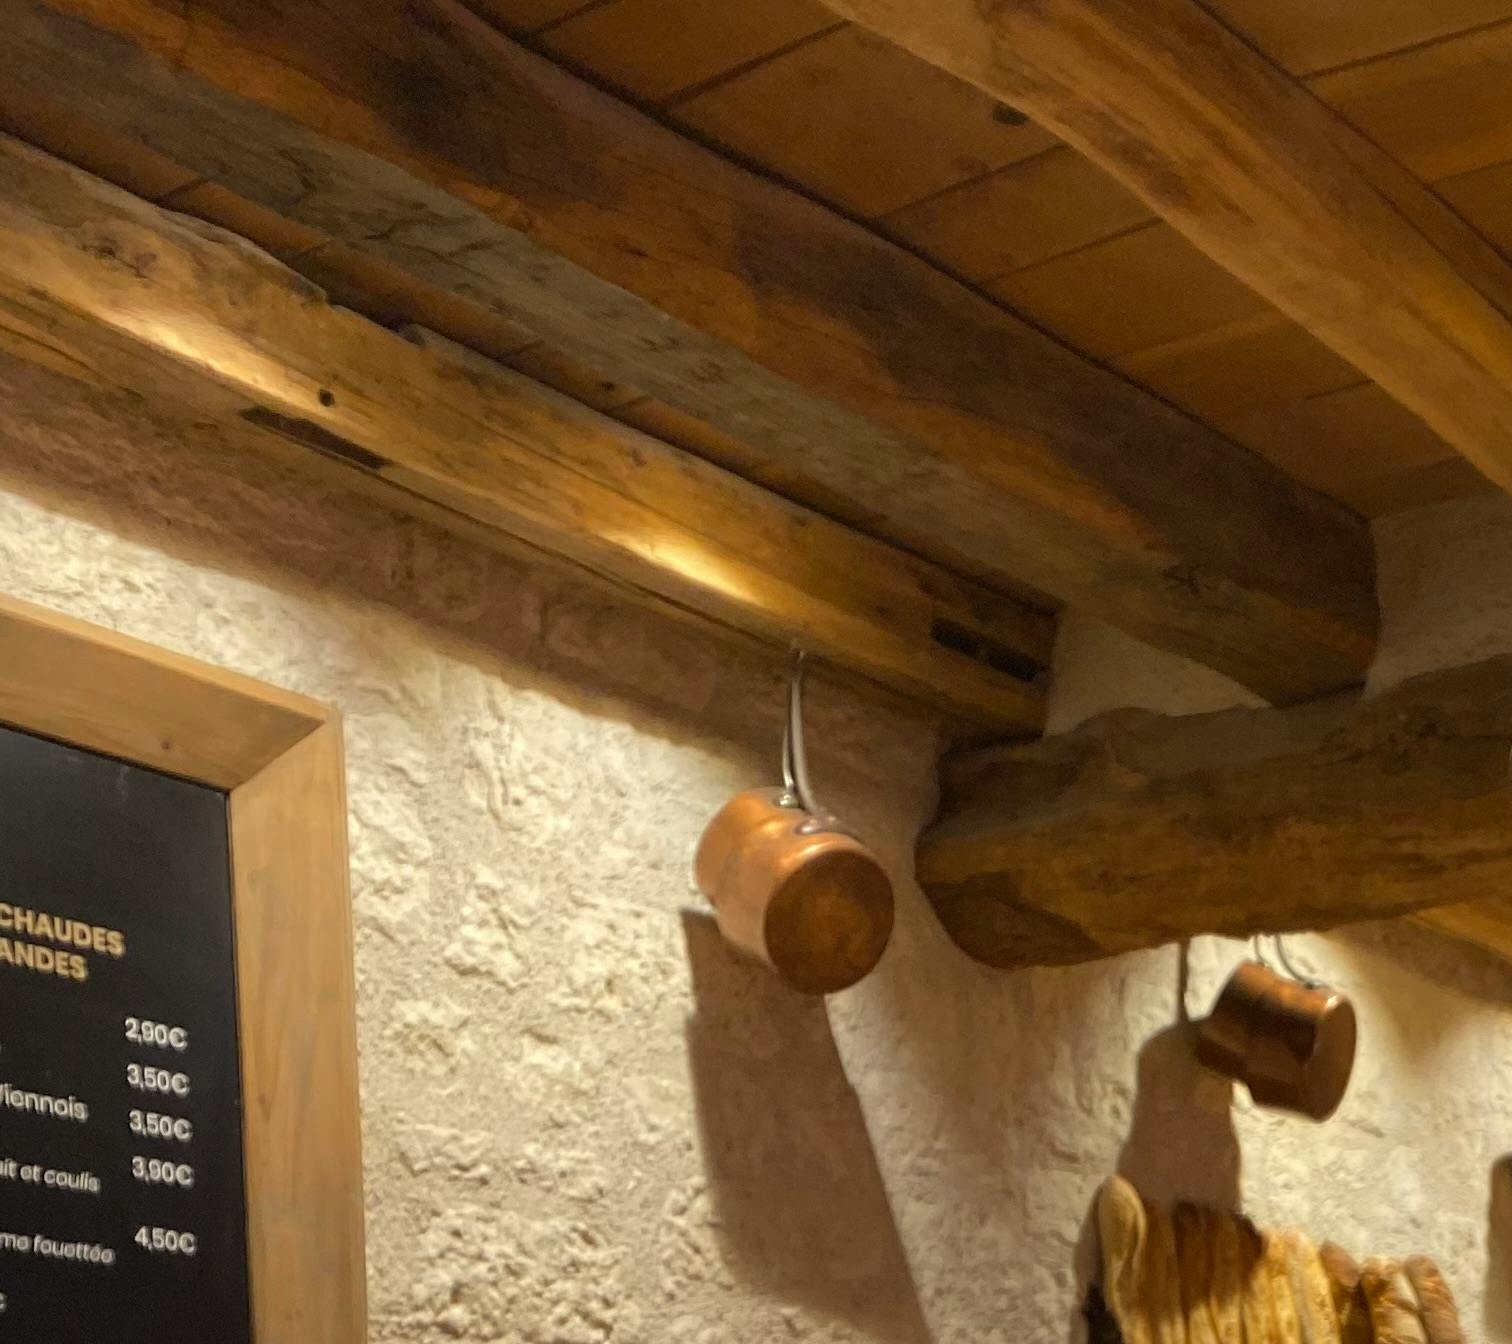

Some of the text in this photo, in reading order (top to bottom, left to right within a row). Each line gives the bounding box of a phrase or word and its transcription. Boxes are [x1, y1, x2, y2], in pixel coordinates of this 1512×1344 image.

[0, 902, 125, 957] CHAUDES
[126, 1063, 191, 1097] 3,50€
[129, 1110, 194, 1142] 3,50€
[134, 1225, 198, 1255] 4,50€
